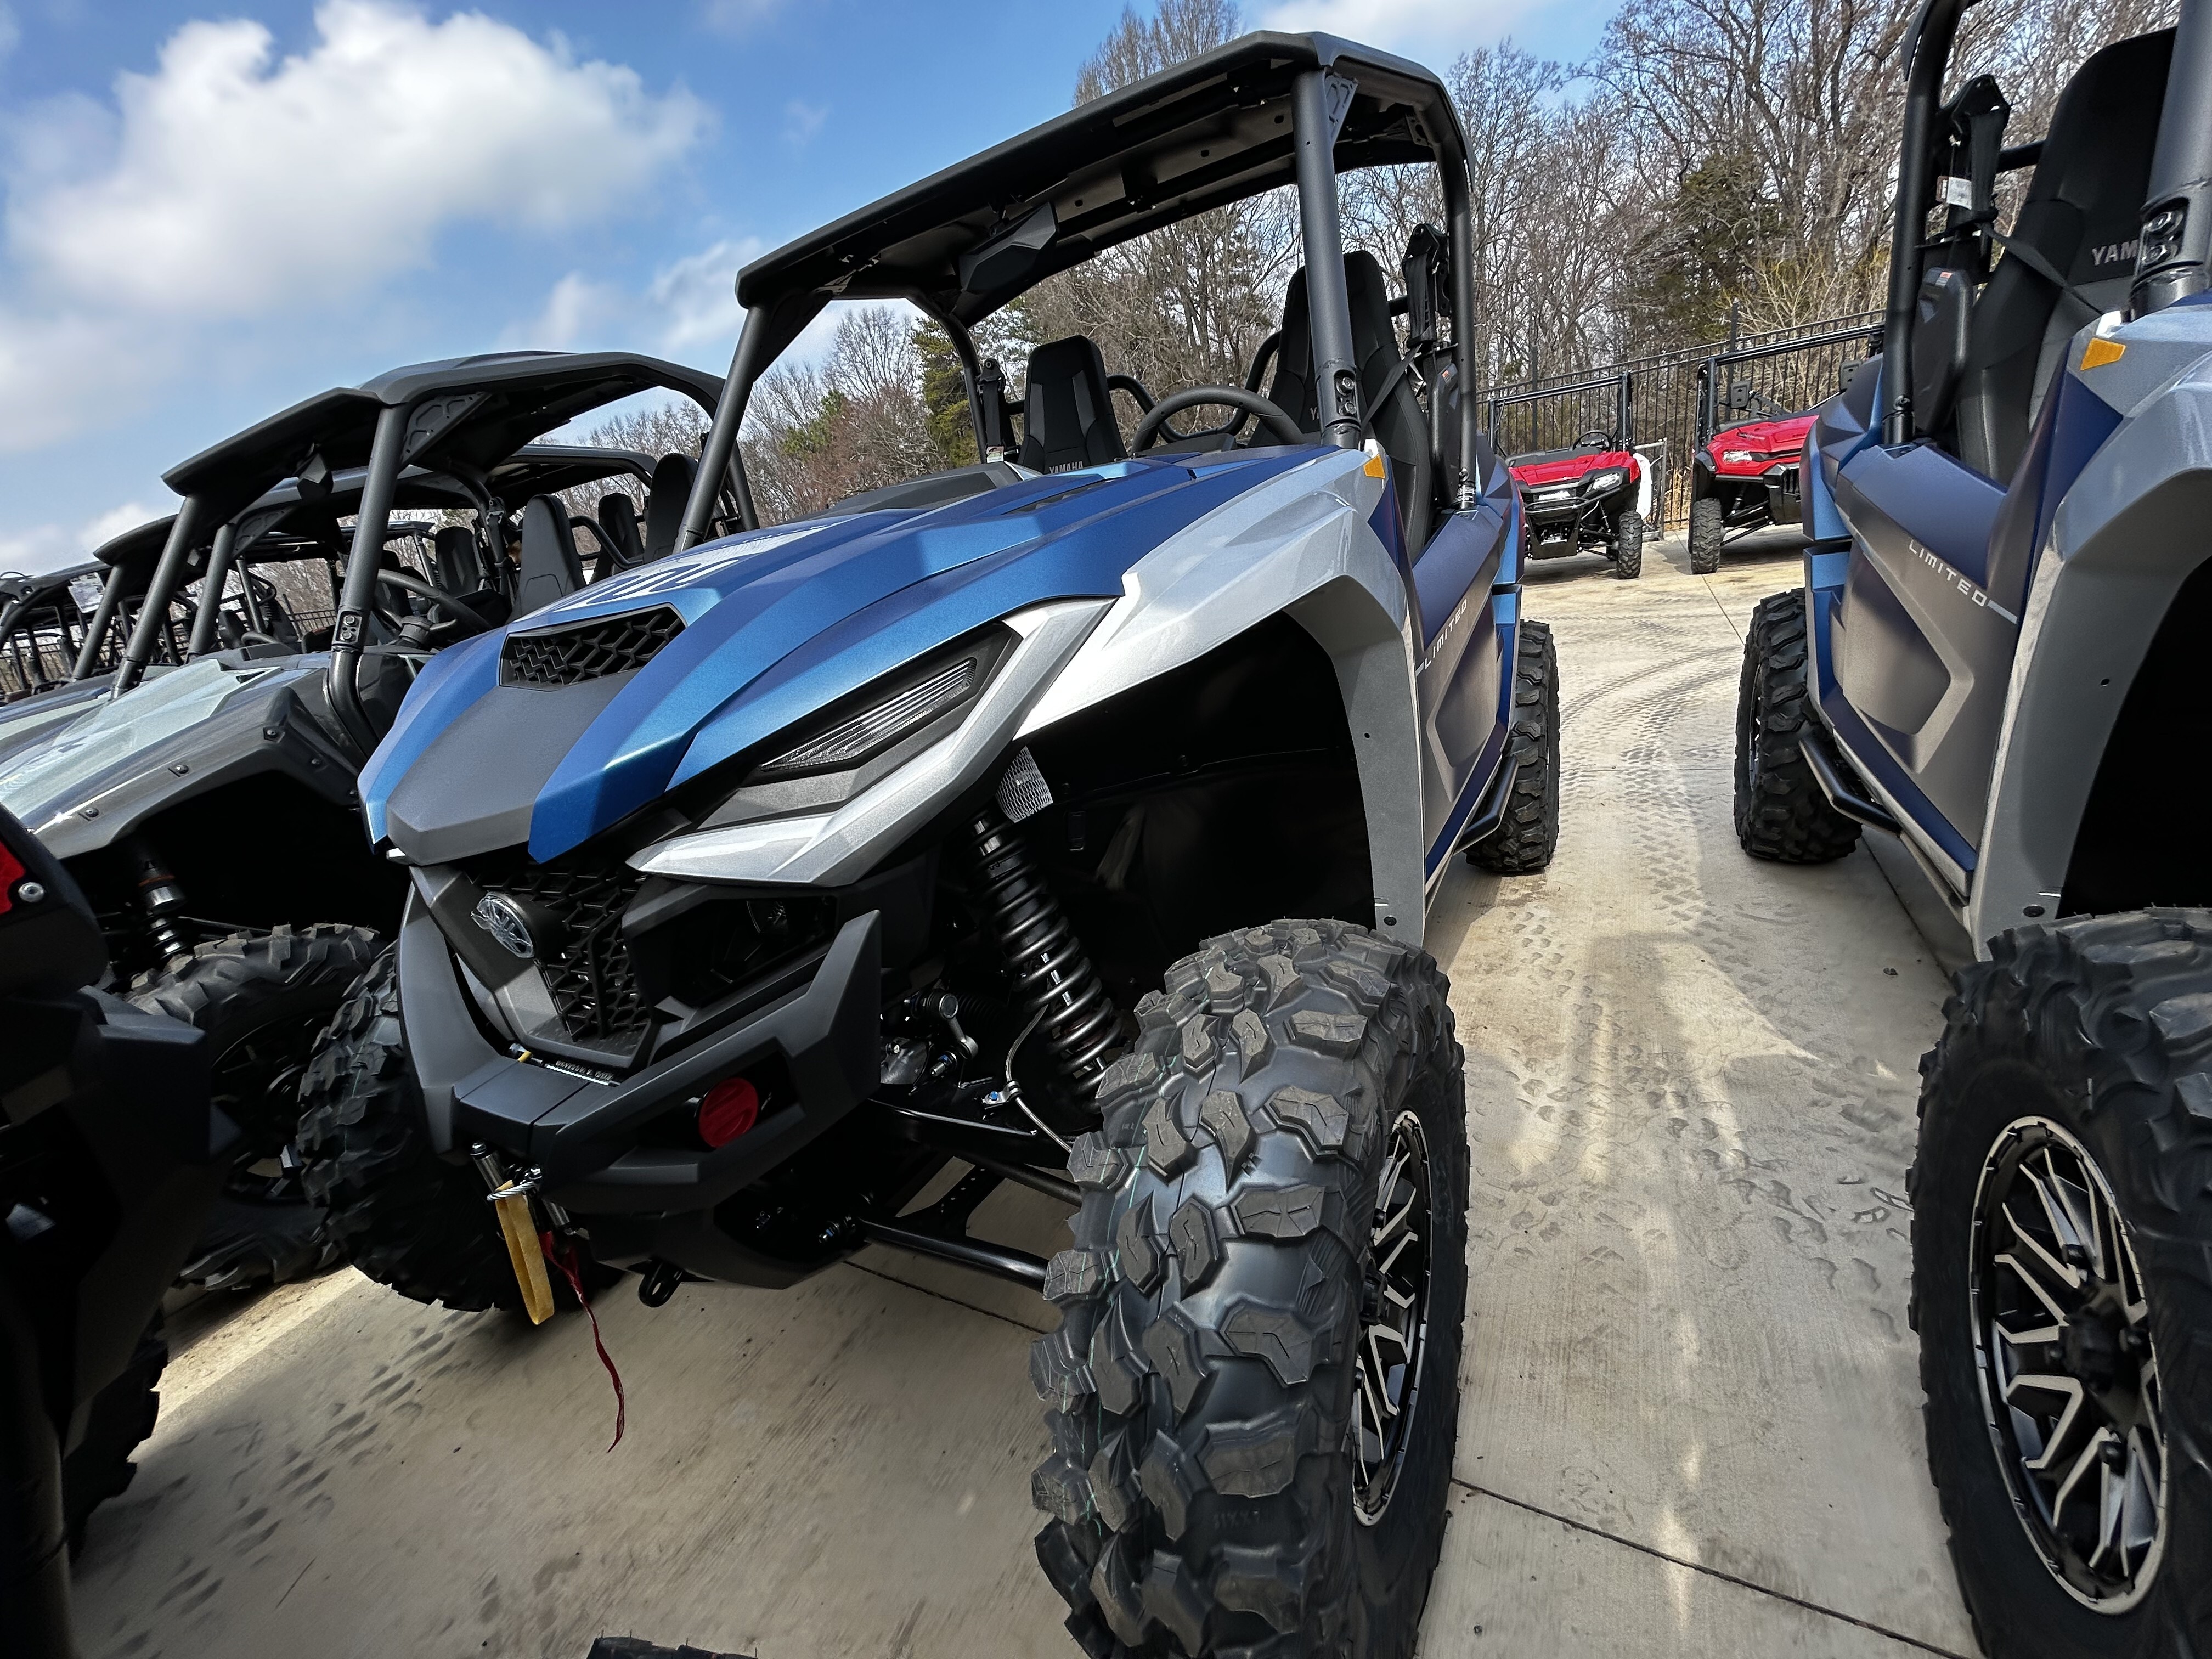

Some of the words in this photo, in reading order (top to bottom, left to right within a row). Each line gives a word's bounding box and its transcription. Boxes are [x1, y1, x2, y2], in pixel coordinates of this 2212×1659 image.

[2092, 239, 2139, 266] YAM
[1049, 460, 1083, 474] YAMAHA
[1909, 540, 1987, 606] LIMITED
[1425, 599, 1467, 669] LIMITED
